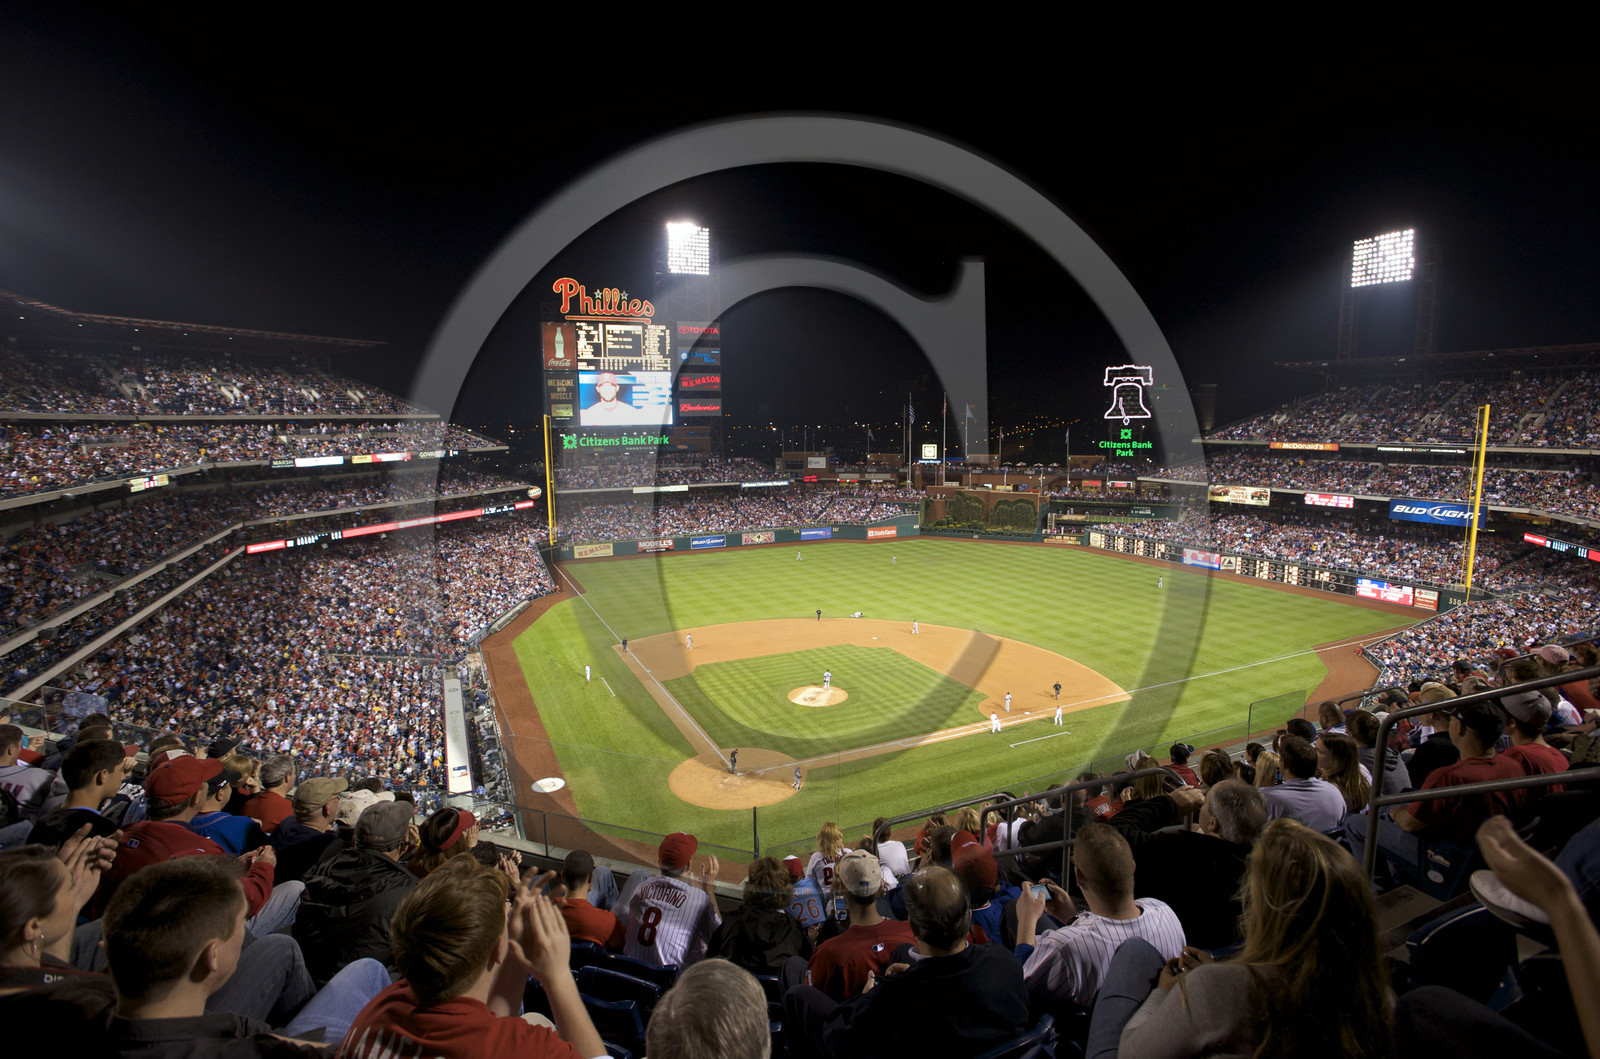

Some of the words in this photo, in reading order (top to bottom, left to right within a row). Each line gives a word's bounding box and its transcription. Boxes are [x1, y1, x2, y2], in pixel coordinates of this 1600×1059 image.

[553, 277, 655, 317] Phillies
[690, 327, 719, 335] TOYOTA
[547, 379, 575, 387] MEDICINE
[551, 392, 573, 400] MUSCLE
[680, 403, 720, 412] Budweiser
[579, 436, 620, 447] Citizens
[621, 435, 647, 445] Bank
[647, 434, 670, 445] Park
[1098, 440, 1131, 449] Citizens
[1131, 440, 1153, 449] Bank
[1282, 442, 1324, 450] McDonald's
[1115, 448, 1134, 457] Park
[1392, 504, 1428, 515] BUD
[638, 539, 673, 548] MODELL'S
[640, 884, 687, 909] VICTORINO
[791, 898, 821, 923] 26
[637, 906, 663, 947] 8
